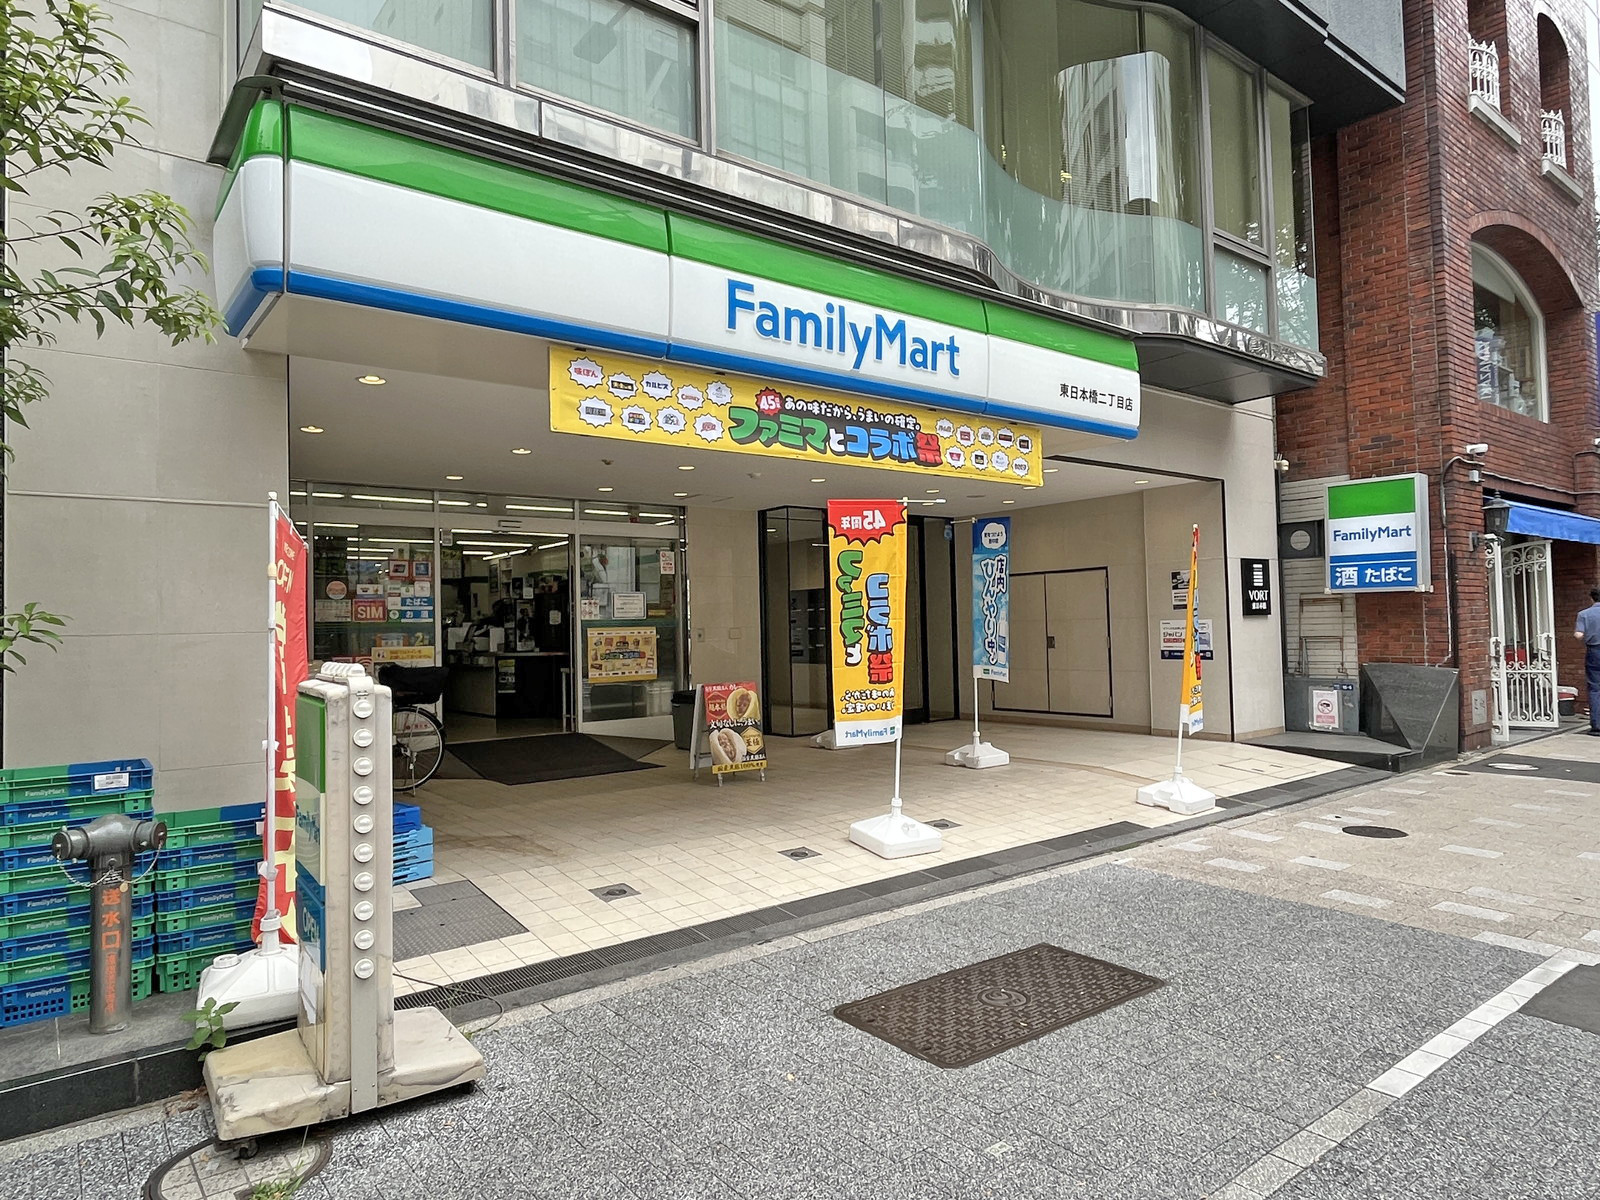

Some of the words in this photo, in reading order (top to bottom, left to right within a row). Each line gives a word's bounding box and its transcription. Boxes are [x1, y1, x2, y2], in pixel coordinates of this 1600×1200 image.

[726, 278, 961, 377] FamilyMart
[645, 380, 669, 391] カルピス
[1058, 381, 1134, 412] 東日本橋二丁目店
[783, 396, 922, 430] あの味だから、うまいの確定。
[728, 406, 944, 468] ファミマとコラボ祭
[1333, 525, 1411, 542] FamilyMart
[1335, 566, 1359, 587] 酒
[1365, 566, 1413, 583] たばこ
[1248, 590, 1269, 601] VORT
[357, 607, 384, 619] SIM
[25, 788, 66, 798] FamilyMart
[28, 810, 58, 819] FamilyMart
[27, 897, 67, 908] FamilyMart
[199, 892, 234, 903] FamilyMart
[101, 888, 122, 950] 送水口
[26, 942, 56, 953] FamilyMart
[26, 986, 66, 1000] FamilyMart
